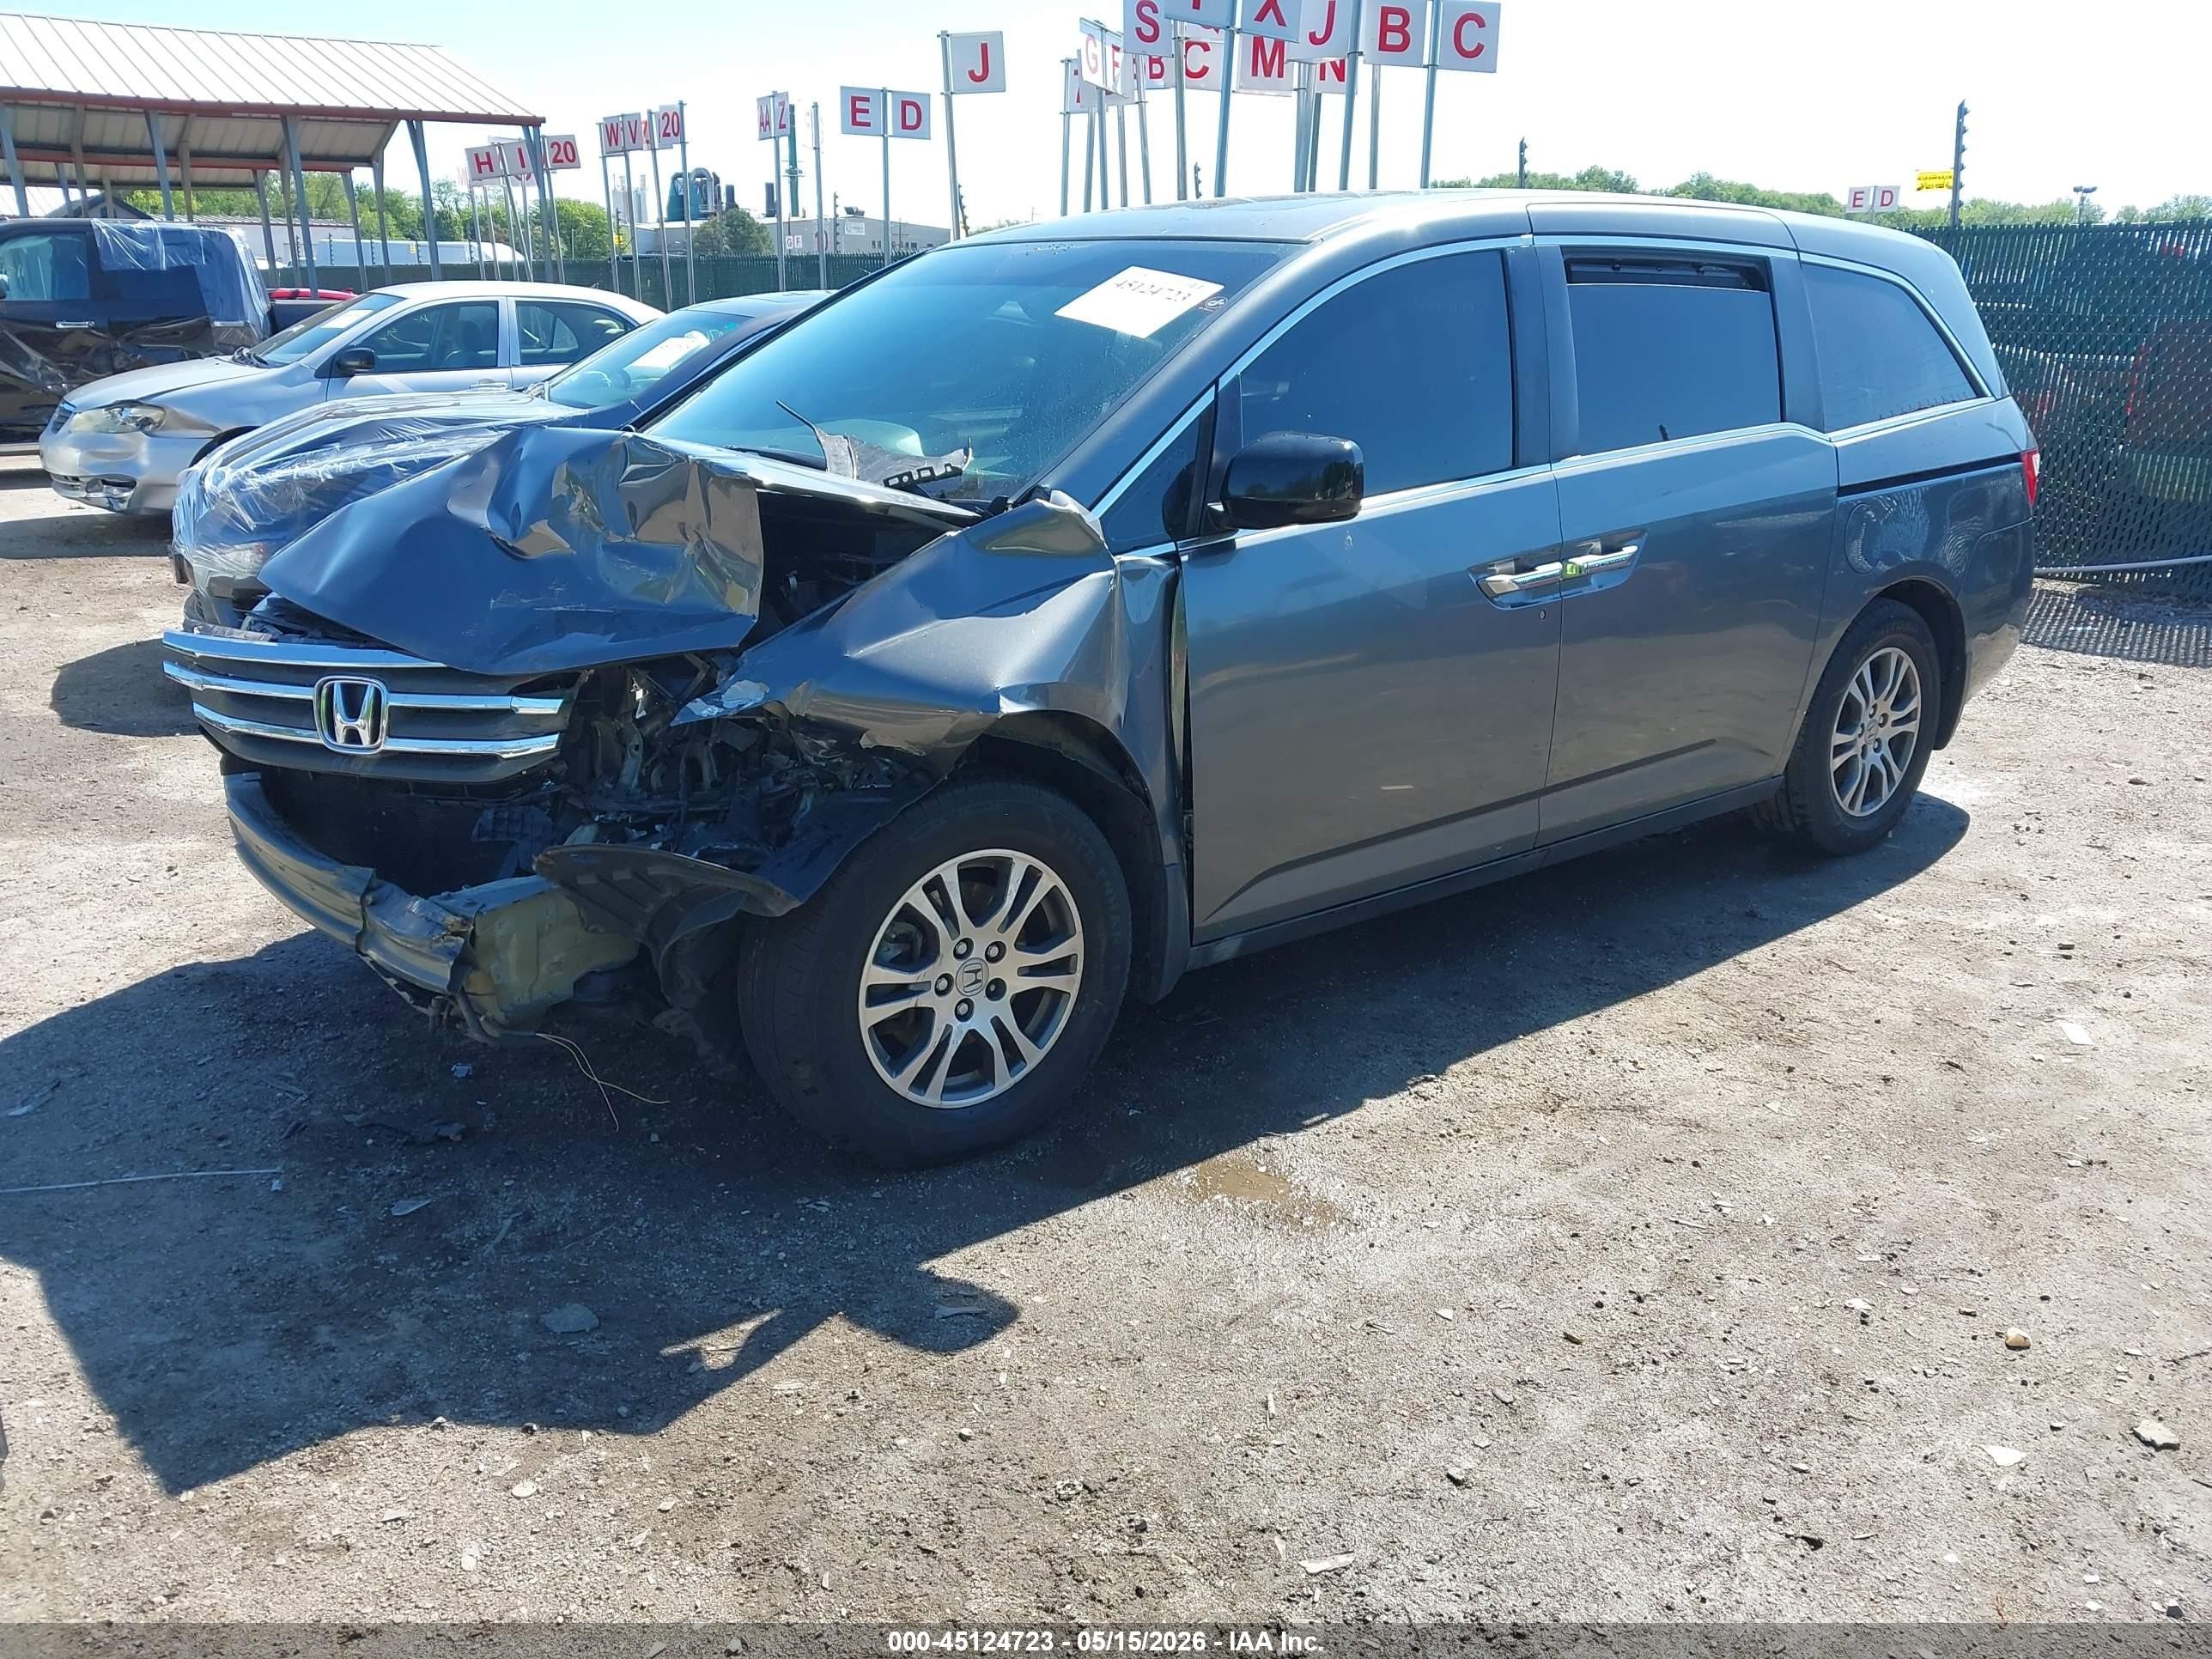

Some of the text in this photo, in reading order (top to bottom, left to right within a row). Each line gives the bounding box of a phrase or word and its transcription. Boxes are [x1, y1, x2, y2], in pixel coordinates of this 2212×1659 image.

[1135, 0, 1159, 42] S
[1309, 0, 1335, 46] J
[1378, 6, 1410, 52] B
[1454, 13, 1486, 58] C
[968, 43, 989, 82] J
[1085, 33, 1098, 74] G
[1185, 40, 1211, 79] C
[1251, 35, 1285, 78] M
[662, 112, 680, 137] 20
[760, 104, 771, 132] AA
[778, 101, 787, 129] Z
[850, 96, 872, 127] E
[901, 100, 922, 131] D
[605, 122, 619, 147] W
[628, 119, 638, 144] V
[474, 151, 495, 174] H
[550, 140, 576, 164] 20
[1852, 191, 1865, 208] E
[1880, 190, 1894, 207] D
